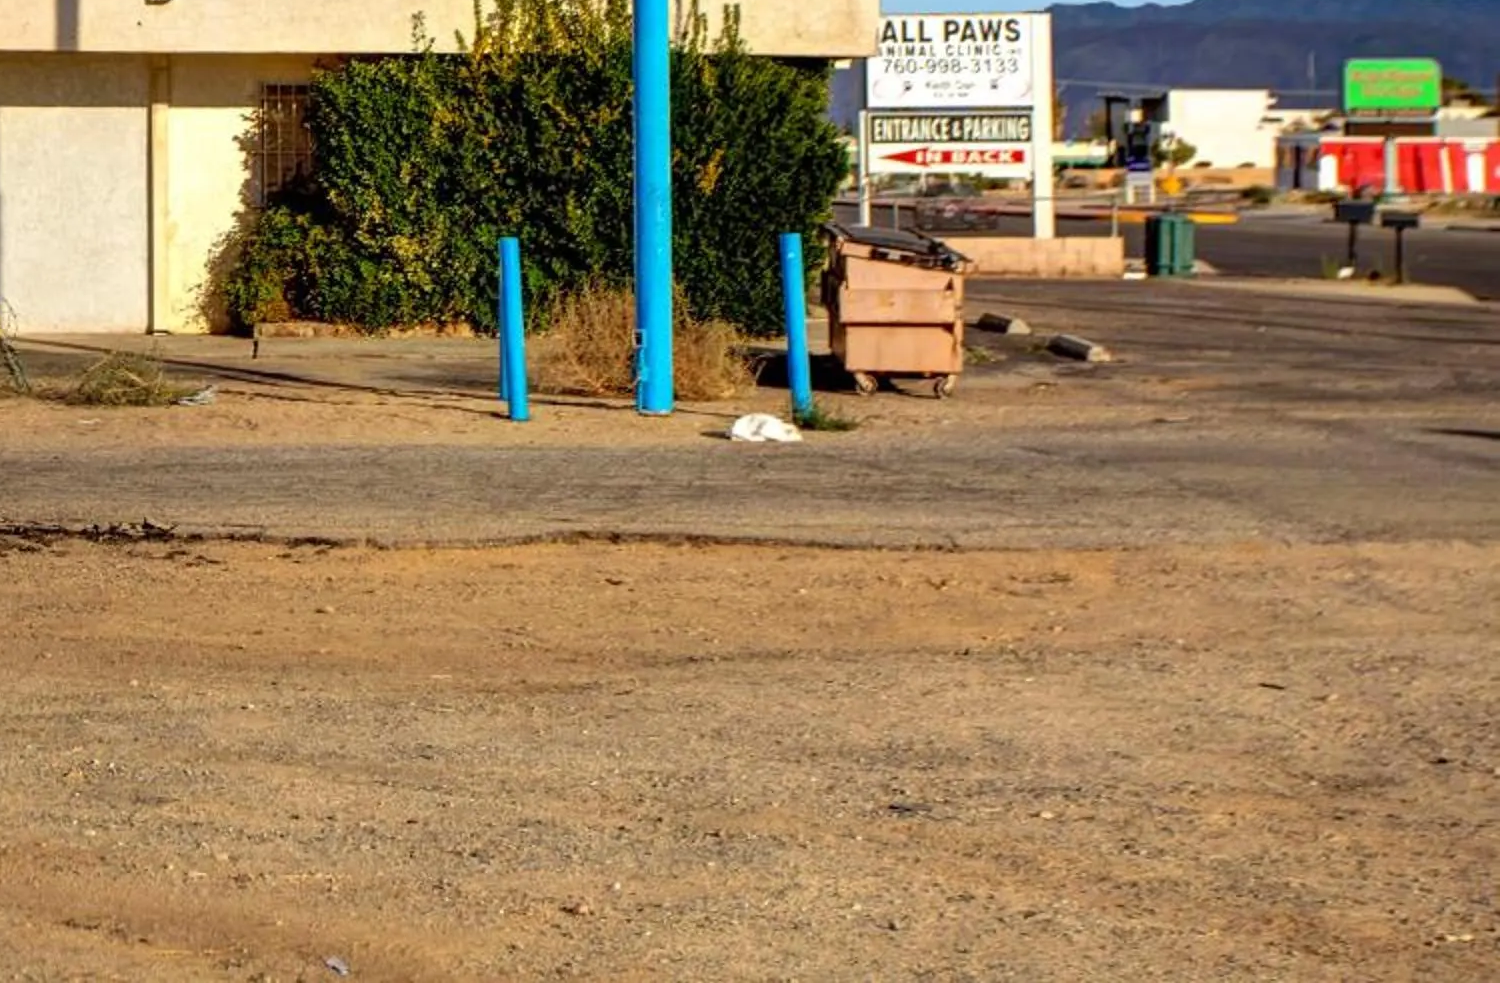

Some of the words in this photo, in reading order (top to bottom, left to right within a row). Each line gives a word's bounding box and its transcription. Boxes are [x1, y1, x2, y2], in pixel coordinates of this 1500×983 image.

[882, 19, 932, 42] ALL
[944, 19, 1021, 42] PAWS
[945, 44, 1002, 57] CLINIC
[884, 59, 1019, 74] 760-998-3133
[874, 118, 949, 142] ENTRANCE
[963, 118, 1029, 140] PARKING
[915, 150, 943, 164] IN
[952, 150, 1012, 164] BACK
